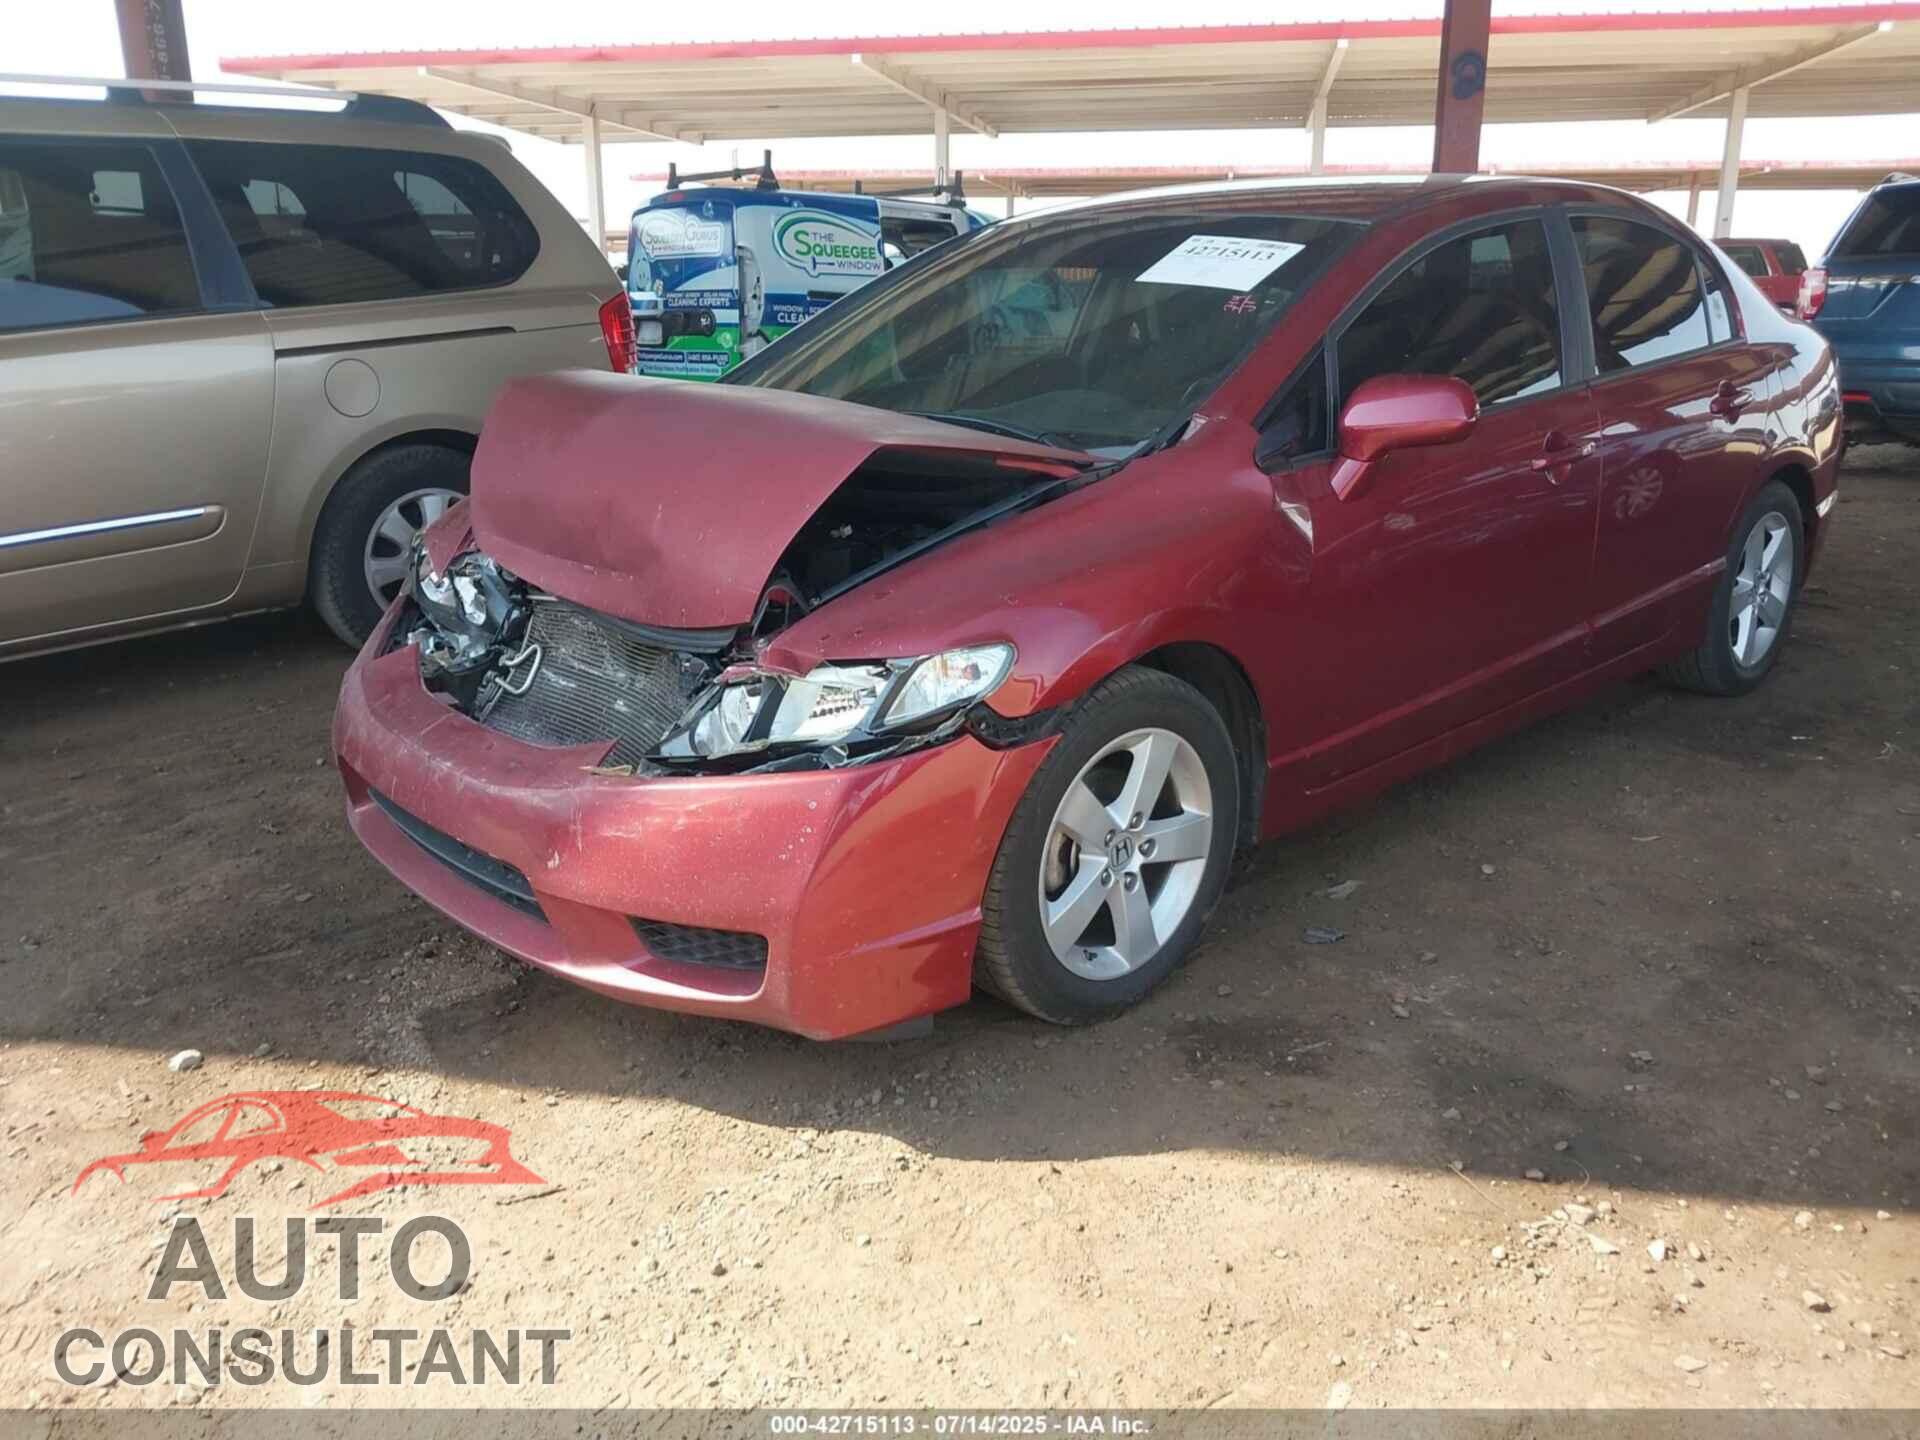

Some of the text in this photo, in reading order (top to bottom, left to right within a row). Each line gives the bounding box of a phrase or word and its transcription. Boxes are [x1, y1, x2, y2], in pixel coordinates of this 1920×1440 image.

[811, 232, 834, 242] THE
[793, 229, 876, 259] SQUEEGEE
[836, 260, 881, 270] WINDOW
[699, 297, 730, 307] EXPERTS
[772, 304, 804, 313] WINDOW
